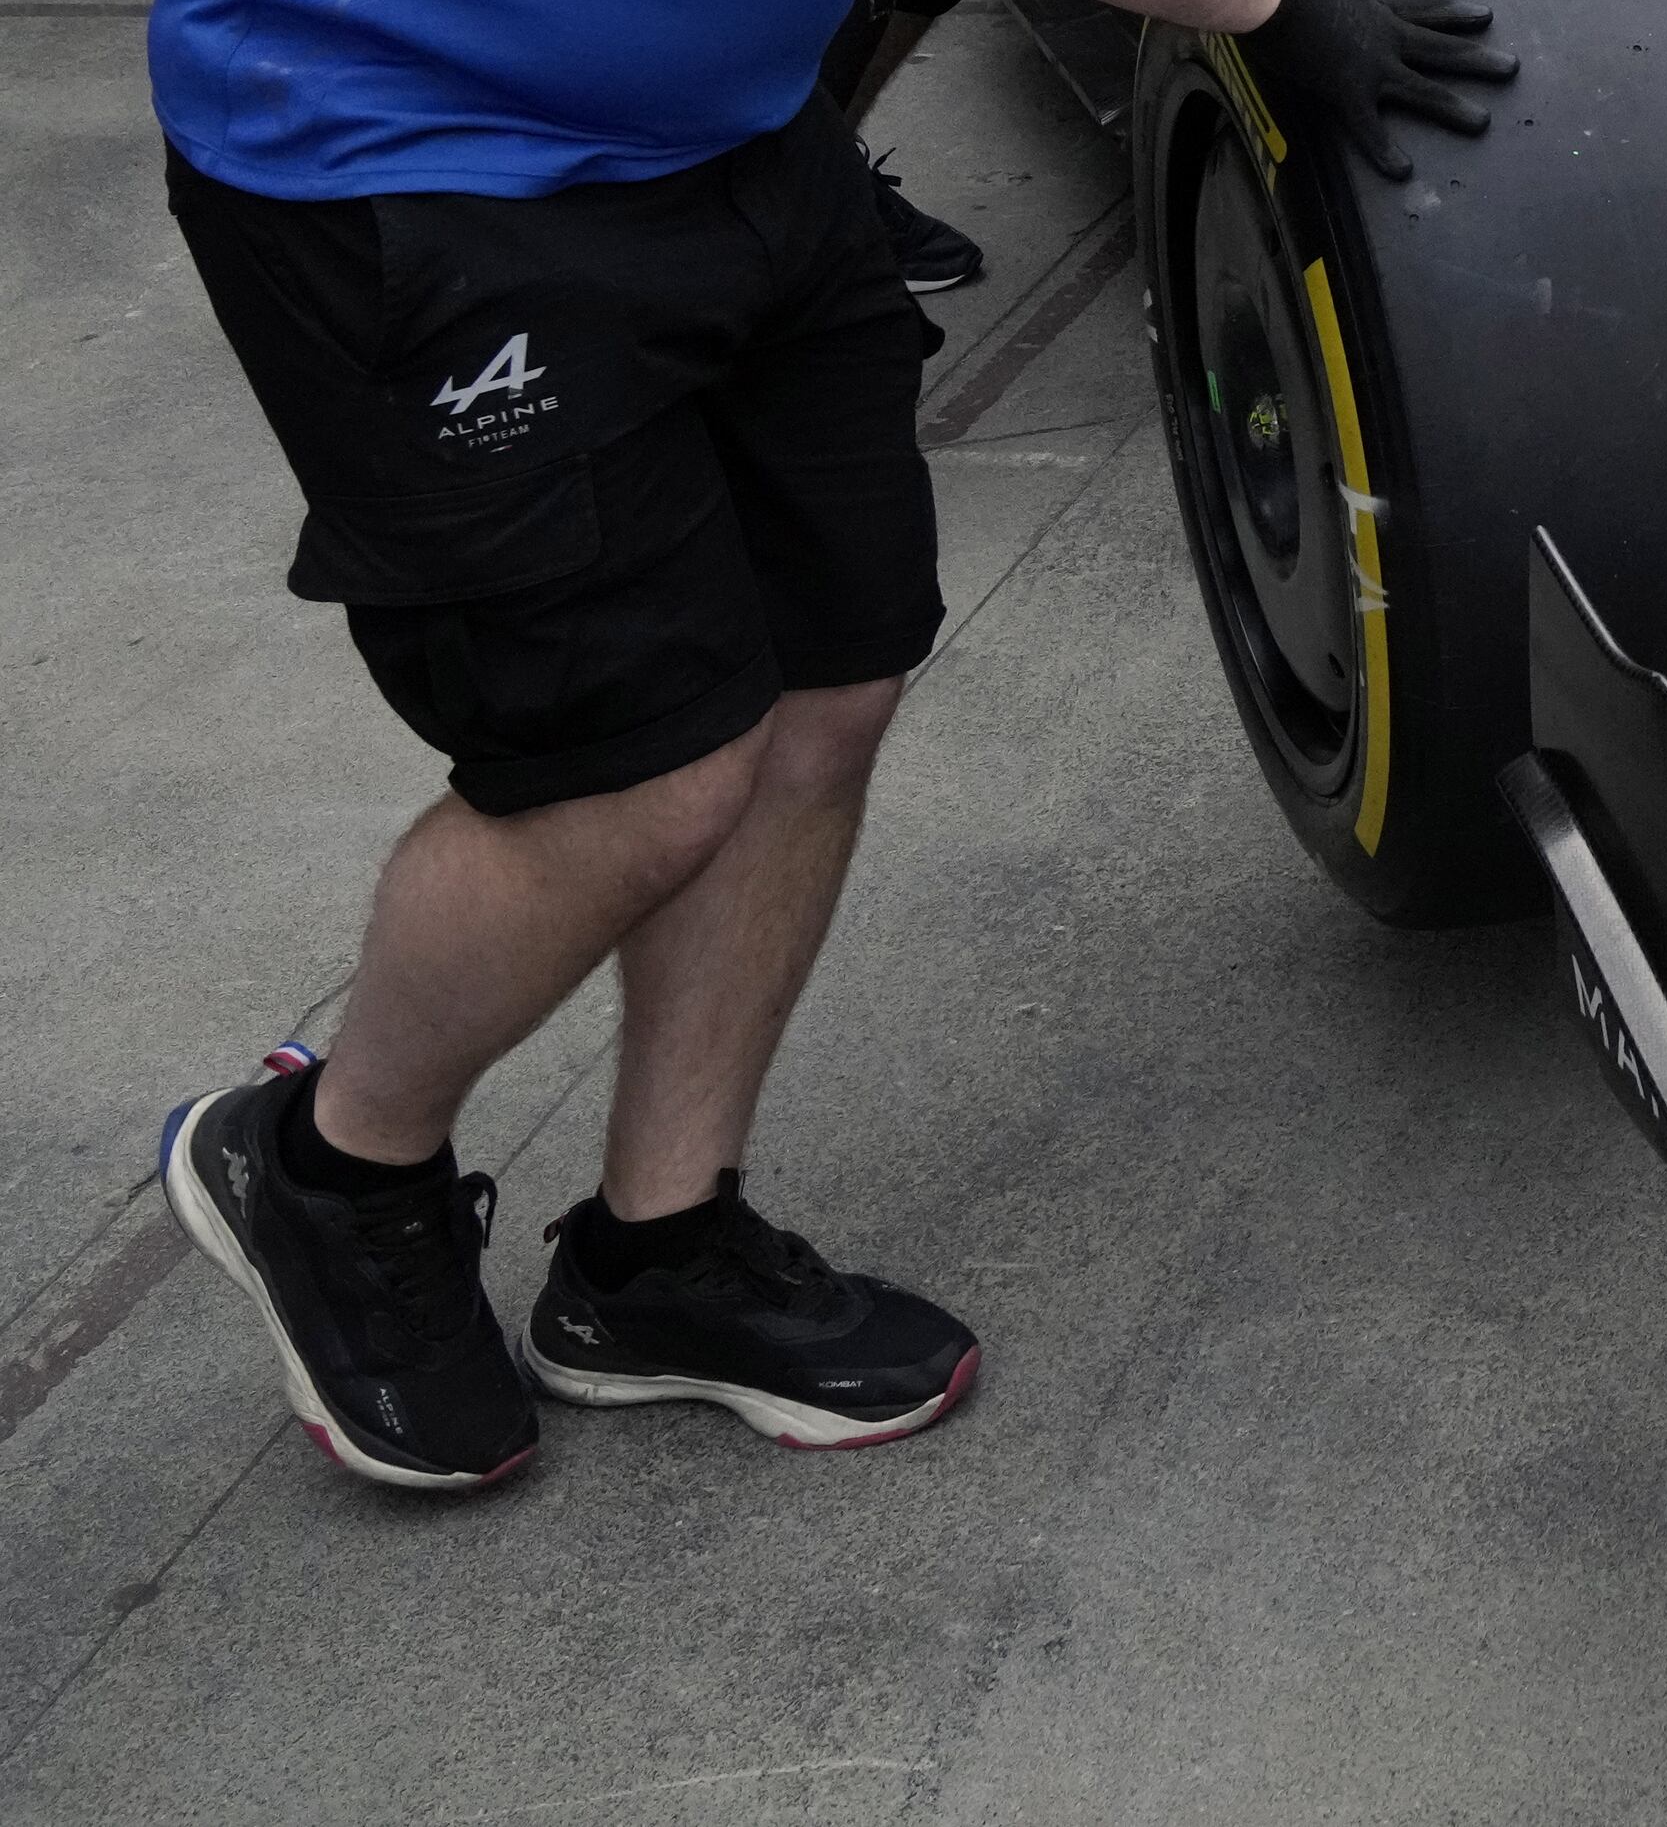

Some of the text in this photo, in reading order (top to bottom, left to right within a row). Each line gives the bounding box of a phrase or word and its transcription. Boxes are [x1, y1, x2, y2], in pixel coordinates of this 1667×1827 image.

[438, 396, 560, 440] ALPINE
[492, 424, 530, 441] TEAM
[818, 1379, 865, 1389] KOMBAT
